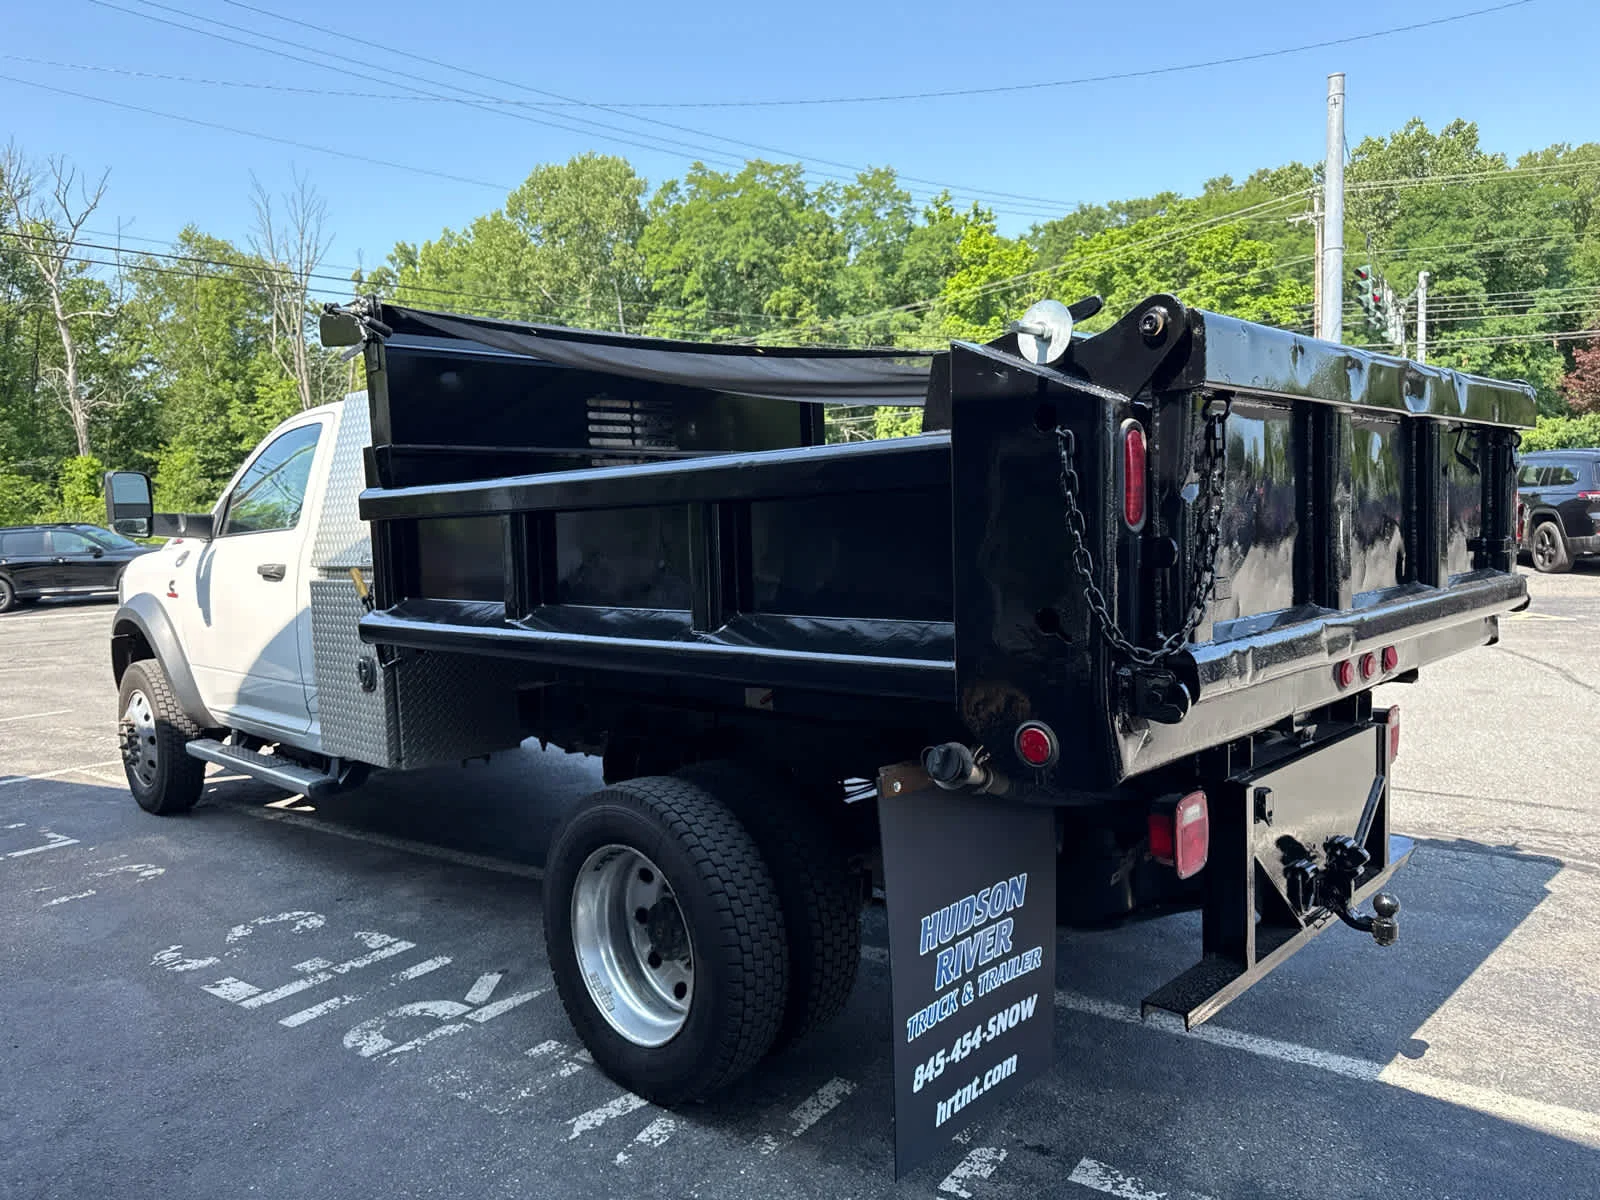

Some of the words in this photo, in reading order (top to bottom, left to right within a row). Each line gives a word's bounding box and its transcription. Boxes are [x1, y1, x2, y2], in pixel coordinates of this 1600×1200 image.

[919, 873, 1028, 956] HUDSON
[934, 917, 1014, 991] RIVER
[906, 991, 959, 1043] TRUCK
[962, 981, 974, 1006] &
[977, 947, 1043, 998] TRAILER
[912, 994, 1038, 1093] 845-454-SNOW
[935, 1054, 1018, 1128] hrtnt.com
